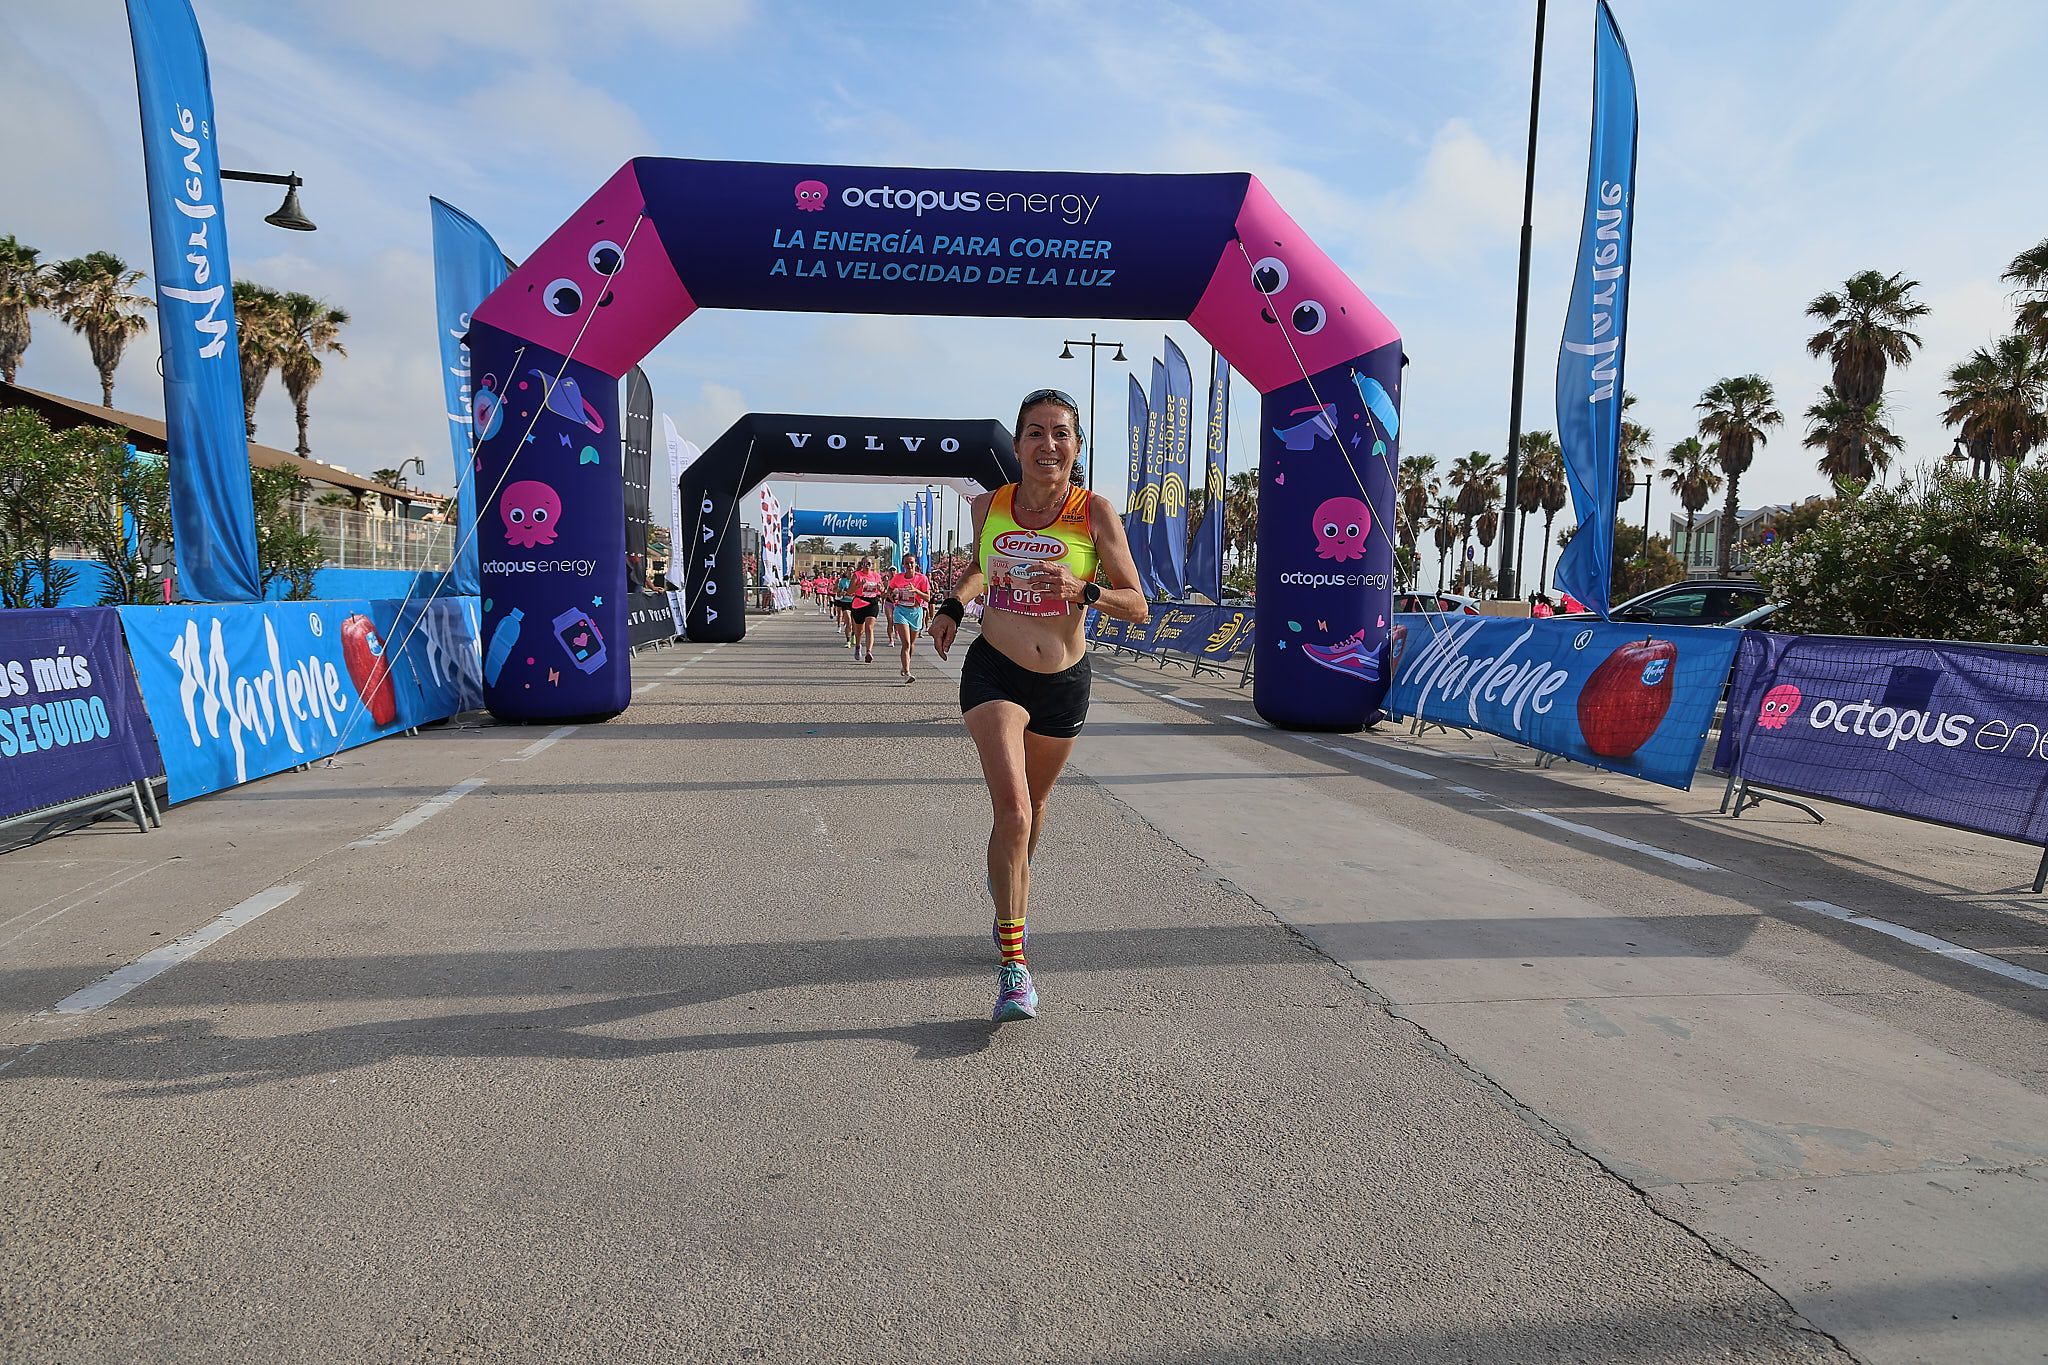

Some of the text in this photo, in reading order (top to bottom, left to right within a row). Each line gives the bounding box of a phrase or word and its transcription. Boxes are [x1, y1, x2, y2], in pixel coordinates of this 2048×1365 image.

[841, 185, 1100, 225] octopus energy
[773, 228, 1112, 260] LA ENERGÍA PARA CORRER
[770, 258, 1116, 288] A LA VELOCIDAD DE LA LUZ
[785, 432, 960, 453] VOLVO
[822, 513, 868, 533] Marlene
[701, 498, 719, 625] VOLVO
[998, 535, 1062, 555] Serrano
[482, 559, 597, 577] octopus energy
[1280, 571, 1389, 590] octopus energy
[30, 646, 92, 693] más
[1401, 618, 1568, 731] Marlene
[169, 613, 347, 783] Marlene
[0, 695, 111, 757] SEGUIDO
[1809, 699, 2048, 762] octopus en
